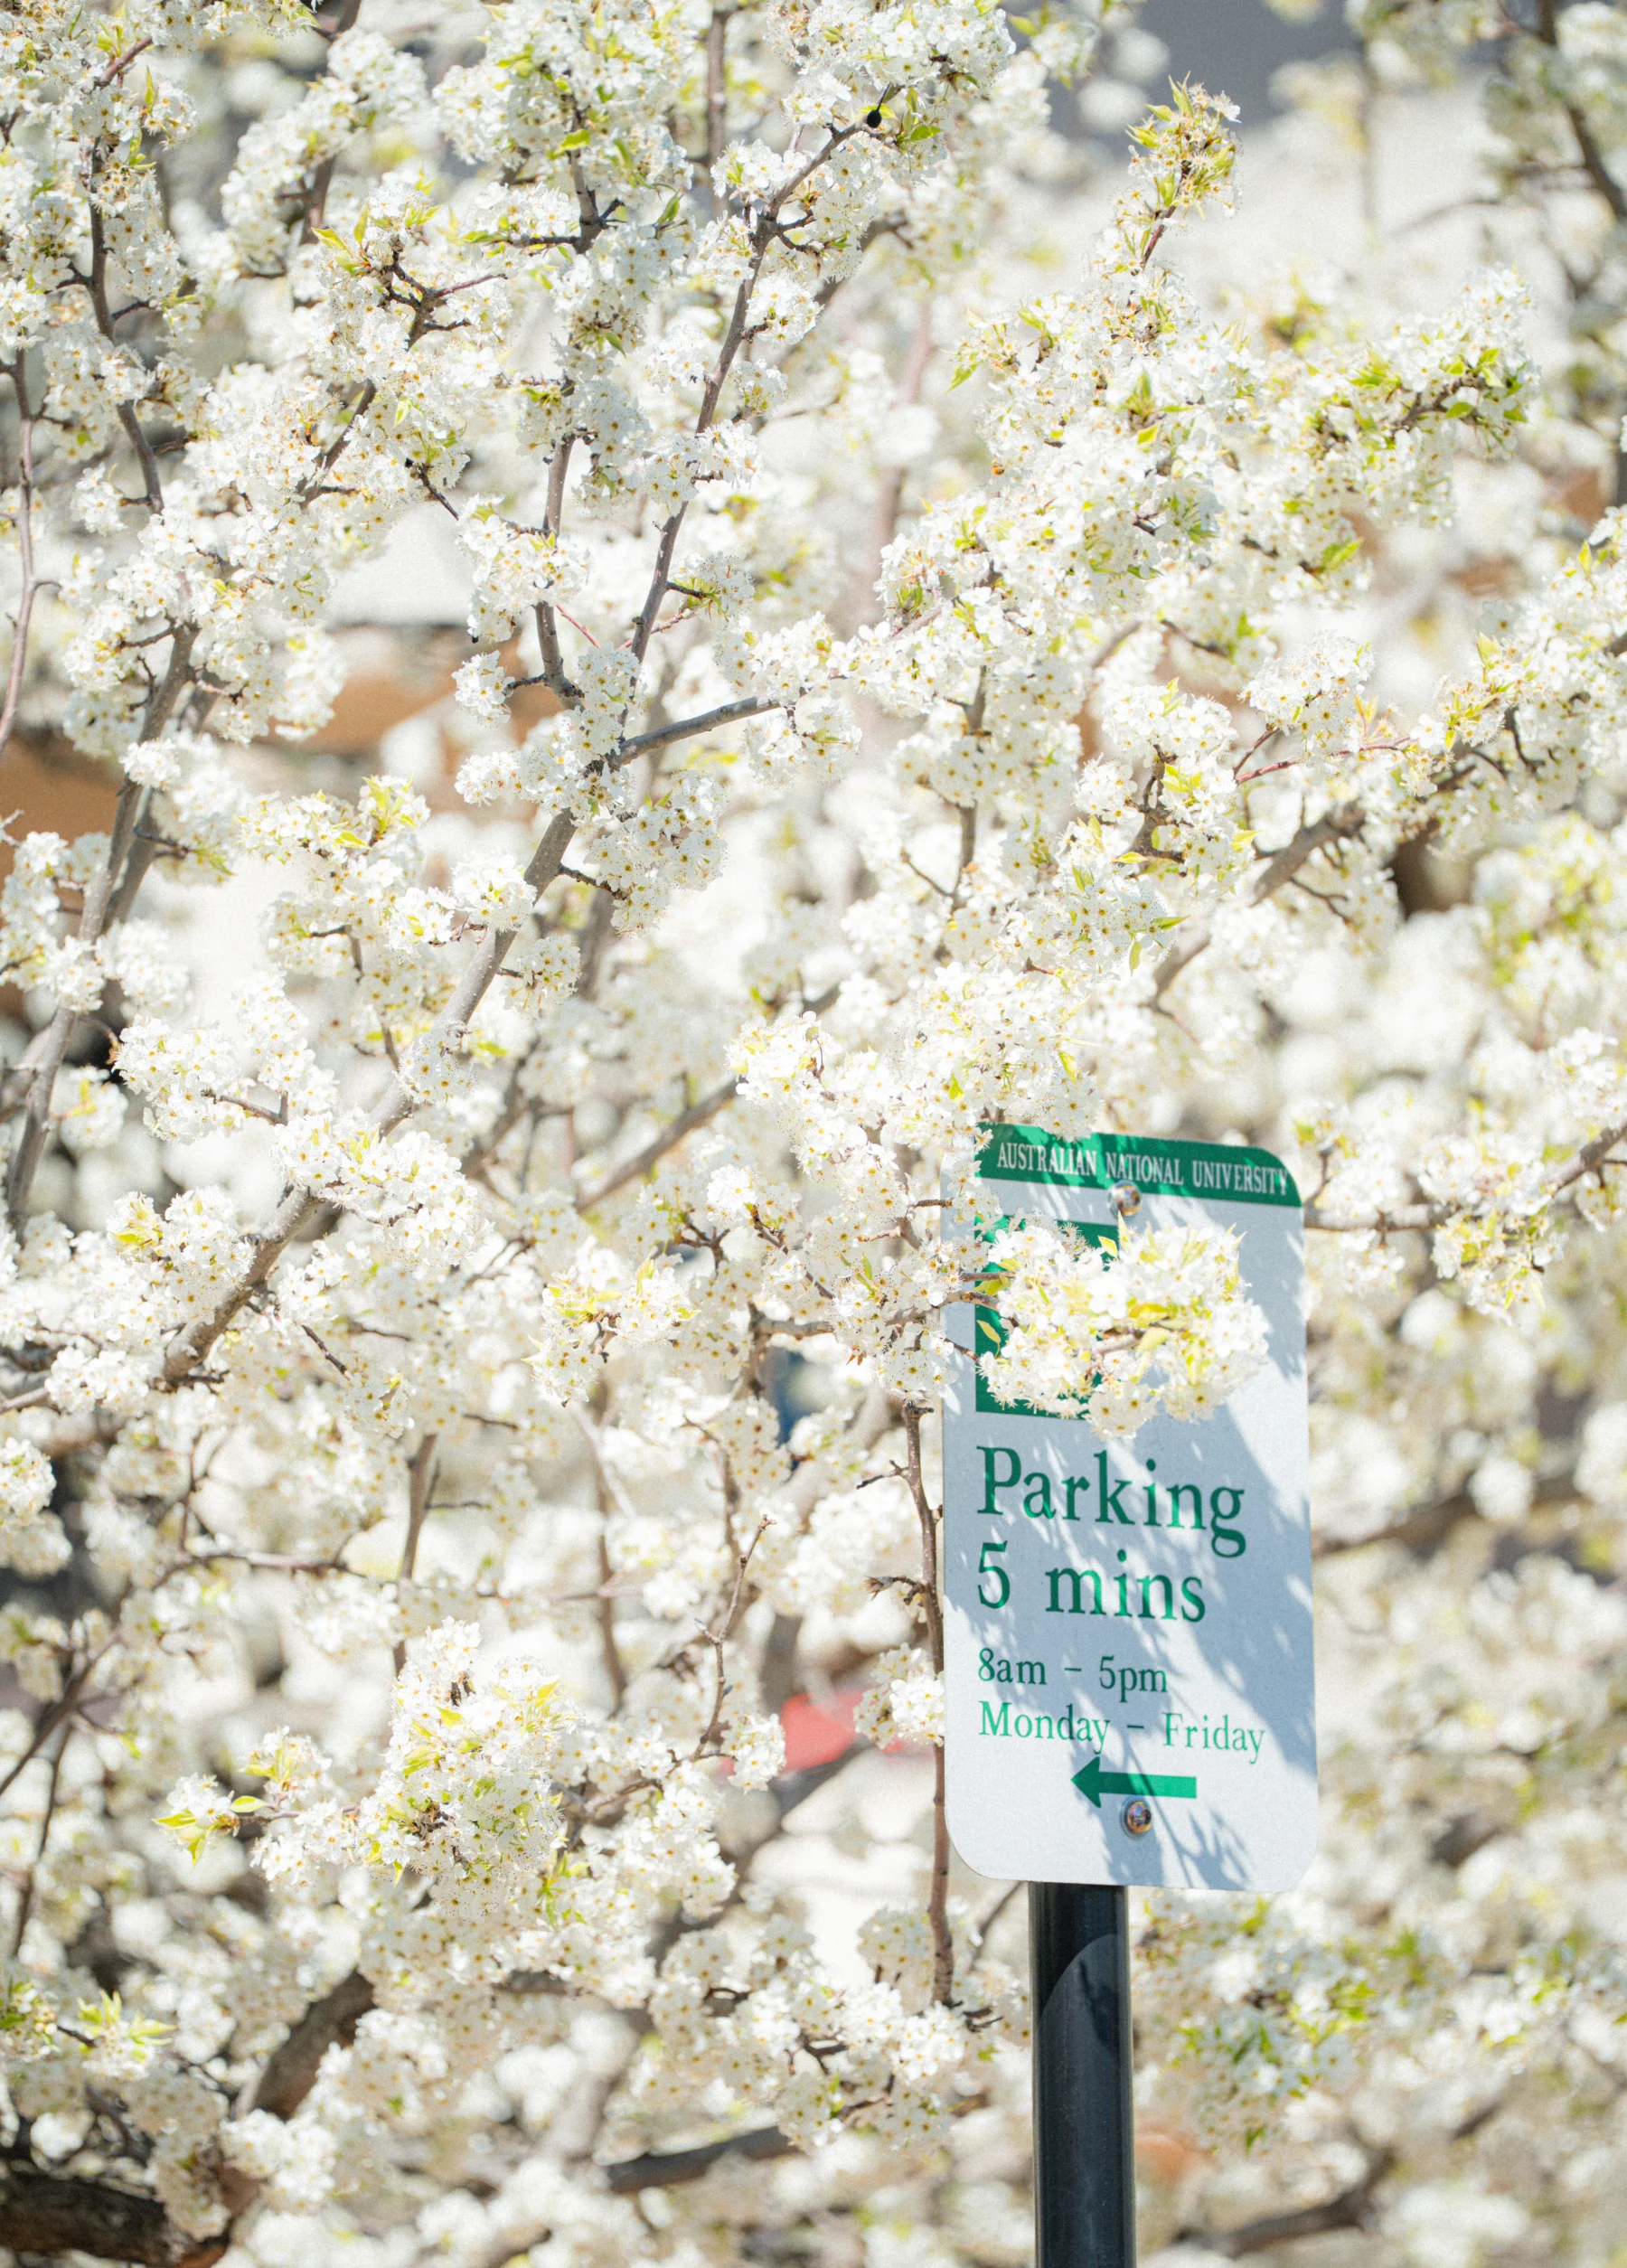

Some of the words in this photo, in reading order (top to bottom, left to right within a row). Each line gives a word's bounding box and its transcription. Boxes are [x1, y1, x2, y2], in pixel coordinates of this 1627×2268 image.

[997, 1142, 1097, 1176] AUSTRALIAN
[1105, 1152, 1185, 1185] NATIONAL
[1191, 1160, 1288, 1195] UNIVERSITY
[976, 1445, 1247, 1558] Parking
[977, 1540, 1011, 1609] 5
[1045, 1548, 1207, 1623] mins
[978, 1648, 1047, 1686] 8am
[1099, 1655, 1169, 1703] 5pm
[979, 1700, 1111, 1755] Monday
[1161, 1712, 1265, 1765] Friday
